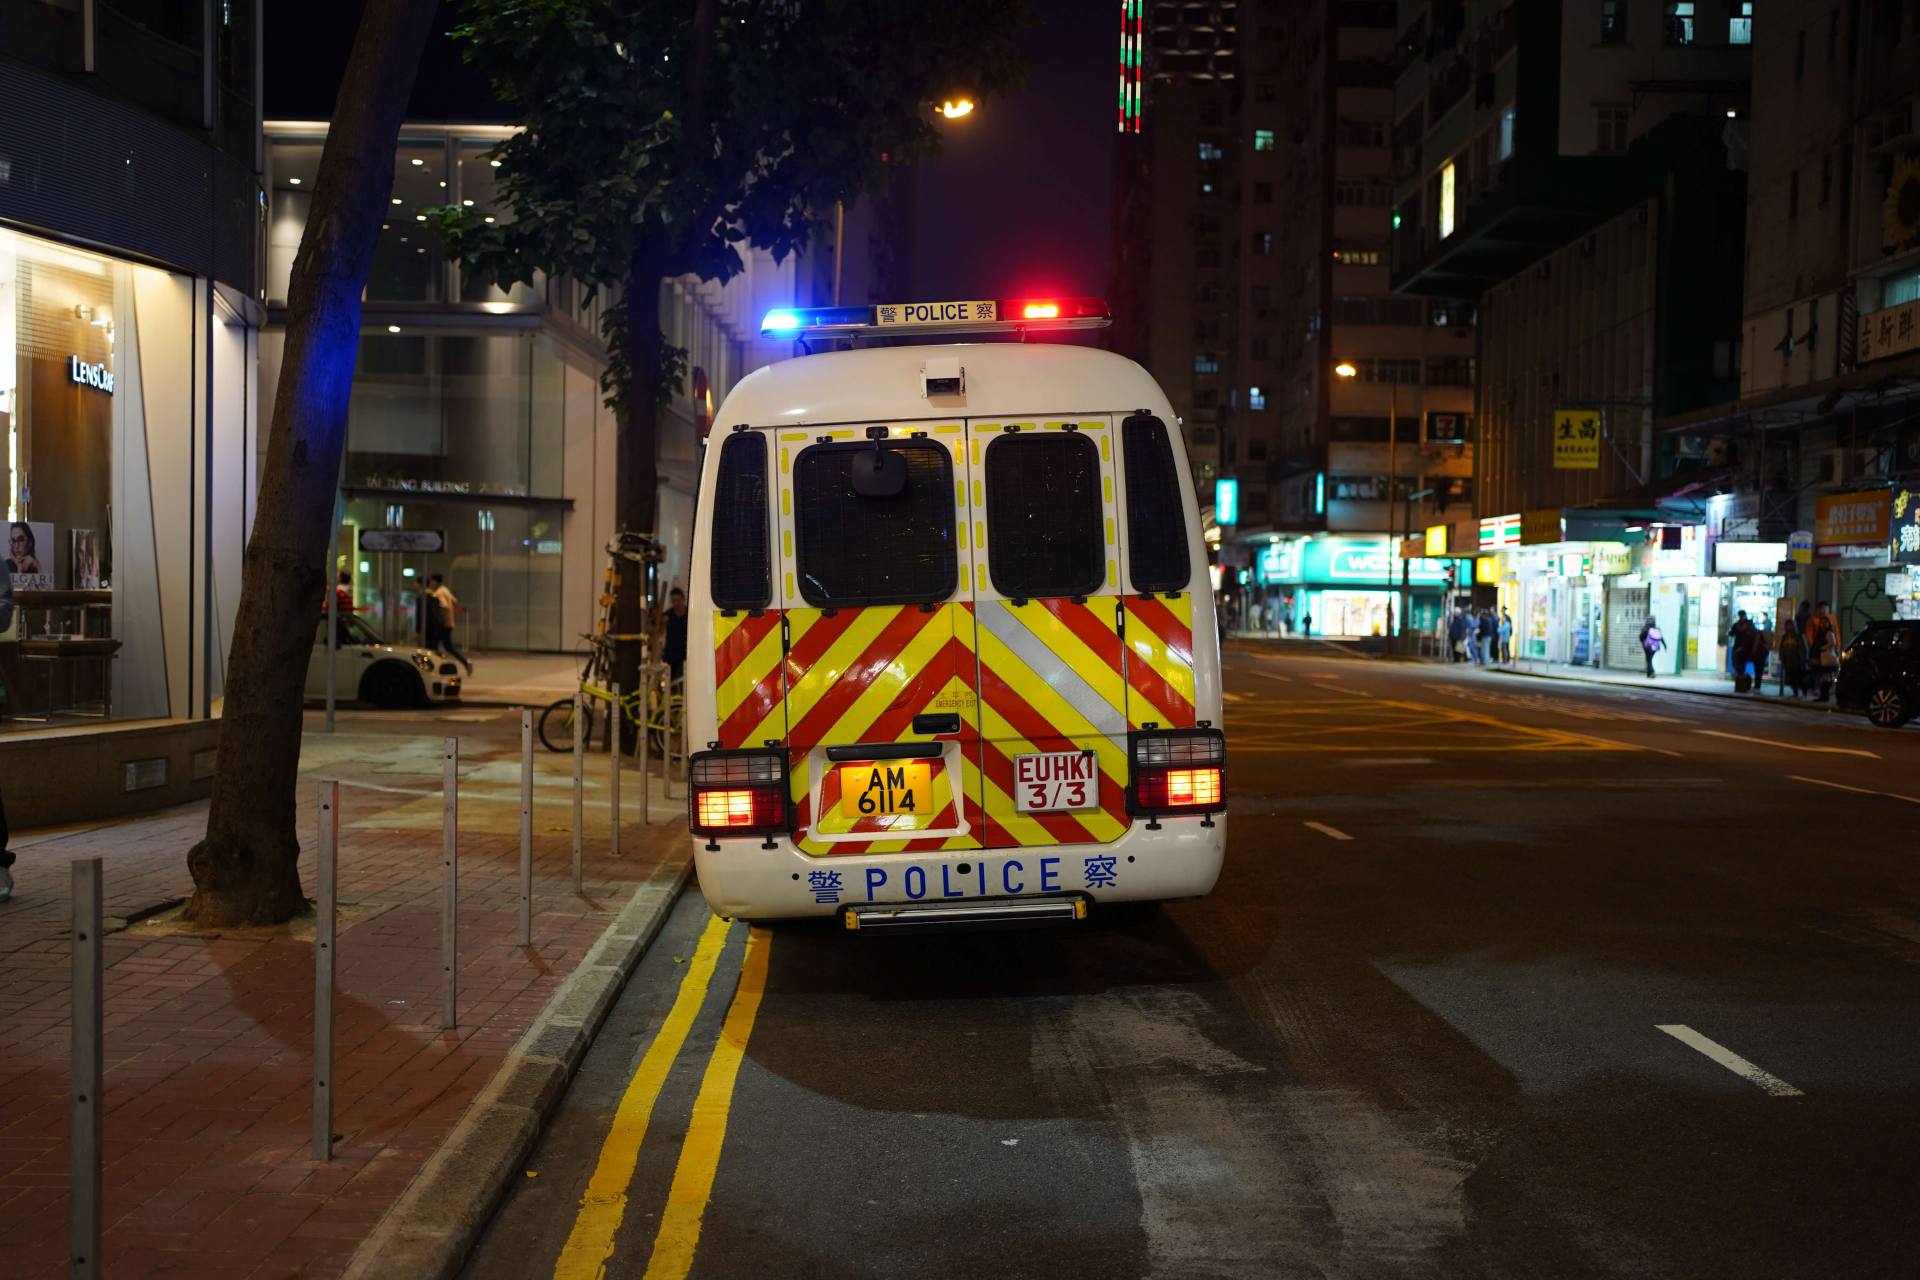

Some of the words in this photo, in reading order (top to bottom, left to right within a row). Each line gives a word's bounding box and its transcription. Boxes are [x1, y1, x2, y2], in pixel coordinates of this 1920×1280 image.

[880, 307, 897, 323] 警
[904, 303, 968, 322] POLICE
[976, 302, 993, 319] 察
[868, 767, 905, 791] AM
[858, 789, 916, 814] 6114
[1028, 781, 1086, 808] 3/3
[807, 870, 844, 904] 警
[866, 857, 1061, 902] POLICE
[1084, 854, 1118, 889] 察
